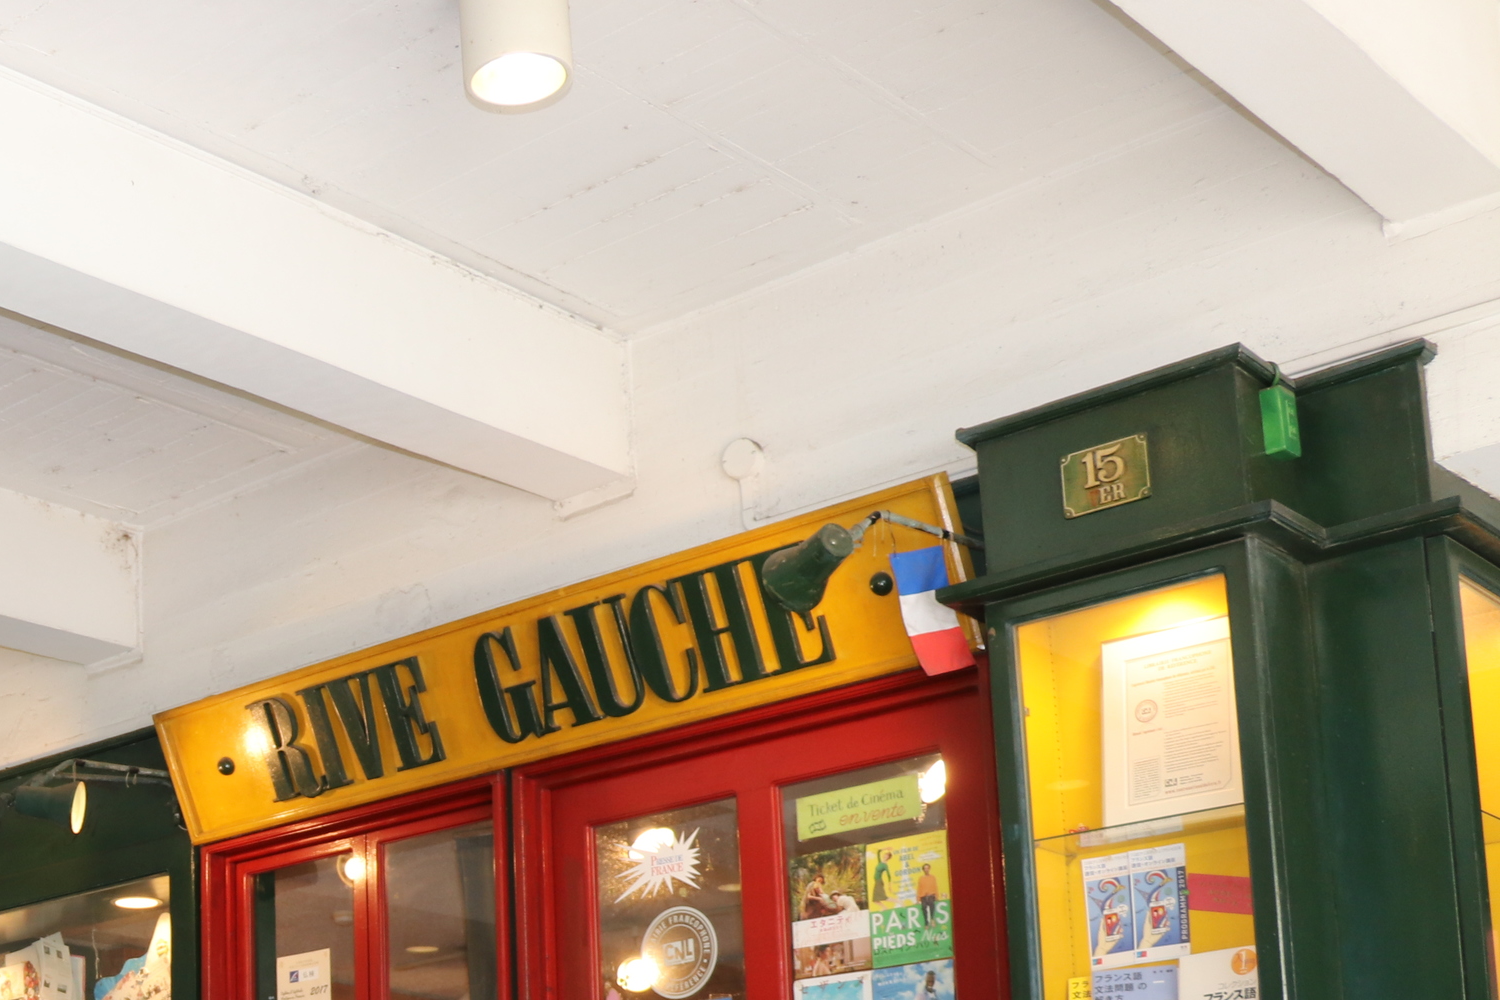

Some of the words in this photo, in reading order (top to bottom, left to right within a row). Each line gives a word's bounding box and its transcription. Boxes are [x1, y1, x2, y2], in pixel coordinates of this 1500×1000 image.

[1081, 443, 1125, 490] 15
[246, 656, 447, 803] RIVE
[808, 799, 843, 817] Ticket
[846, 797, 860, 809] de
[861, 789, 904, 806] Cinéma
[839, 813, 862, 827] en
[863, 803, 907, 822] vente
[650, 862, 684, 877] FRANCE
[871, 901, 950, 936] PARIS
[668, 914, 711, 954] FRANCOPHONE
[873, 933, 917, 951] PIEDS
[664, 938, 693, 962] CNL
[1094, 972, 1142, 983] フランス語
[310, 984, 329, 996] 2017
